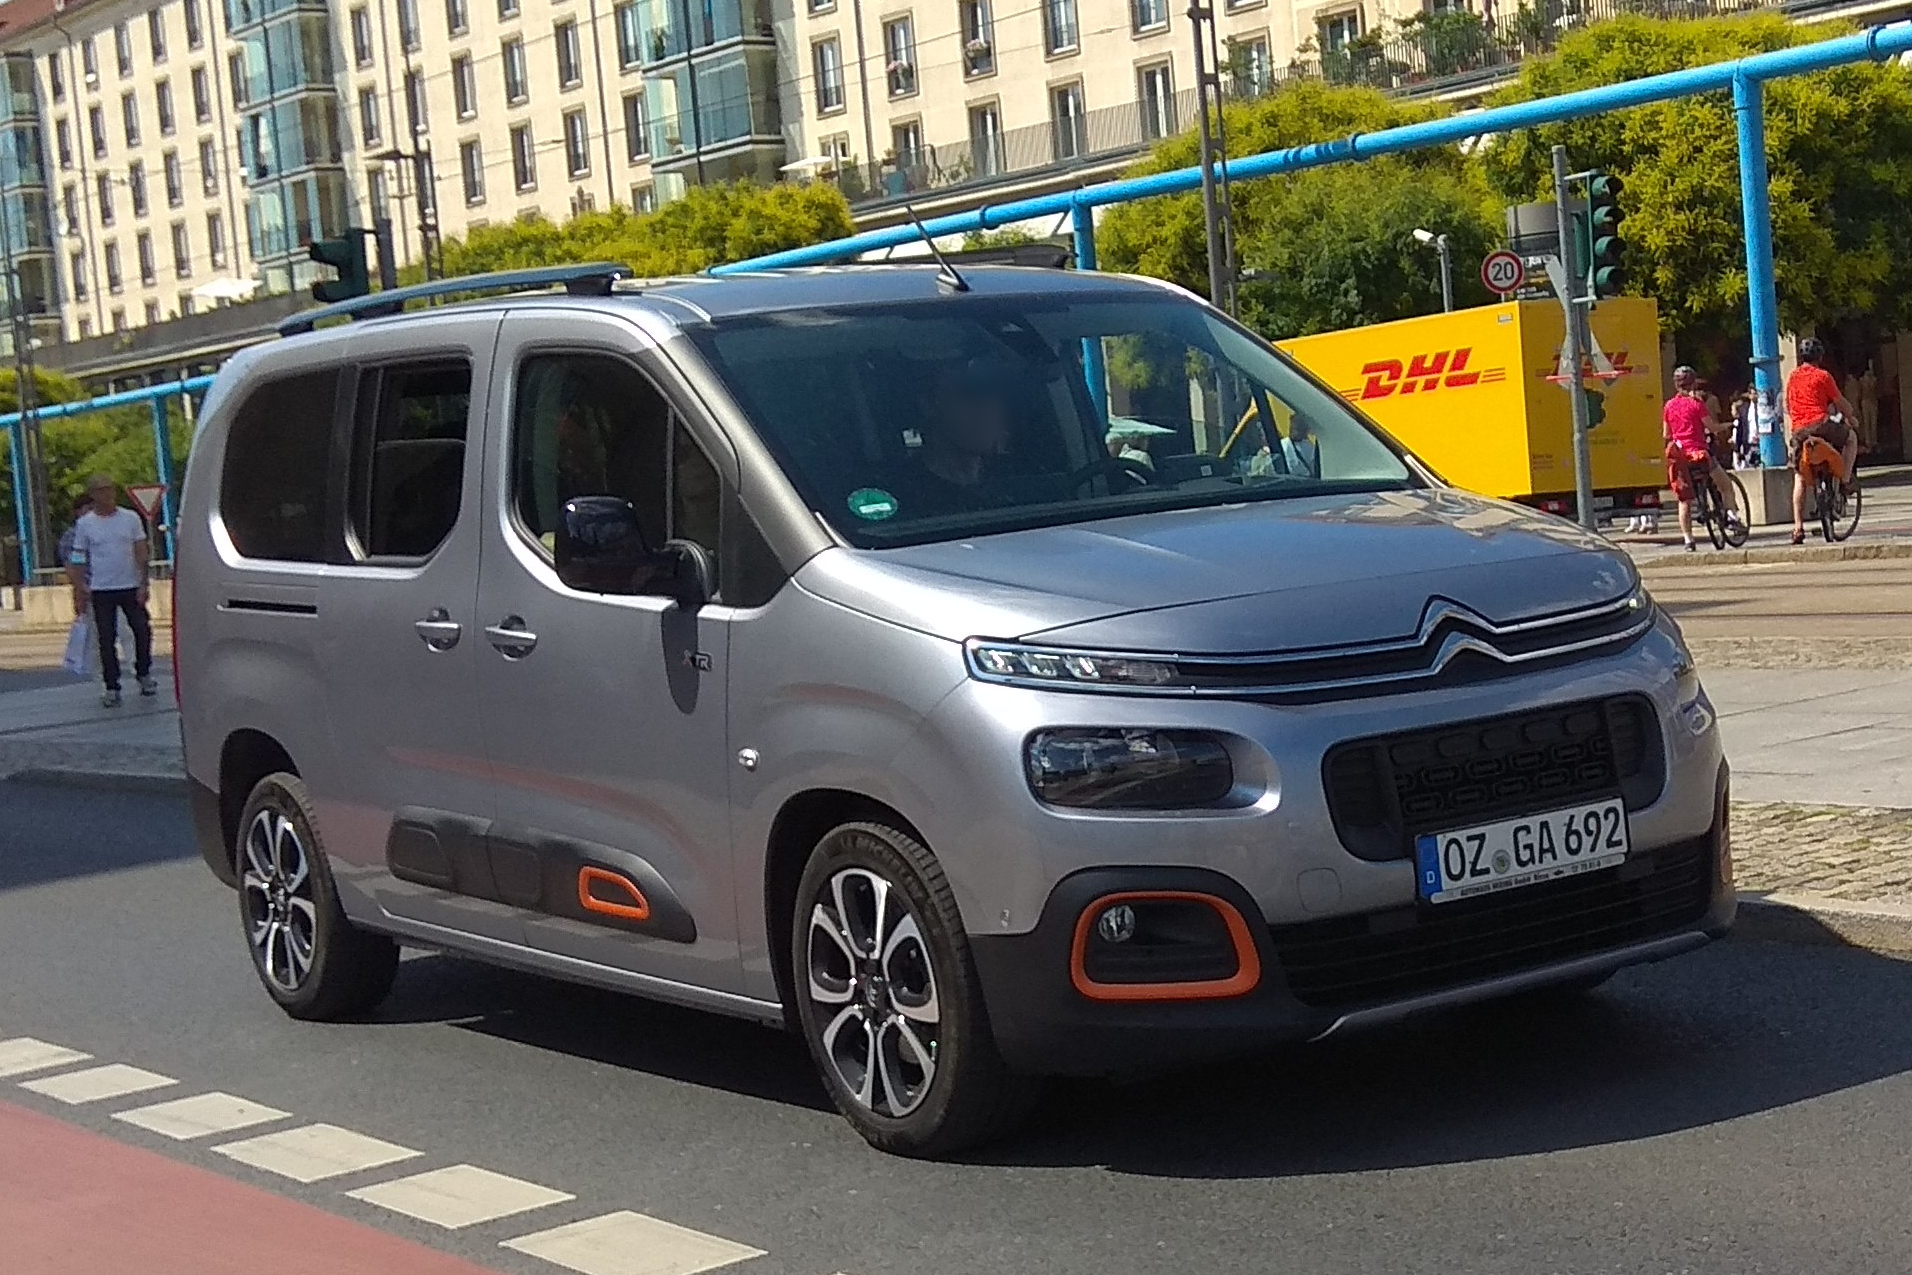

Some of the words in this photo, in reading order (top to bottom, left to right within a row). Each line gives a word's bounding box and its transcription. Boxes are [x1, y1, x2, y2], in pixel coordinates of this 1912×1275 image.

[1491, 261, 1515, 282] 20
[1360, 346, 1482, 401] DHL
[1443, 832, 1491, 882] OZ
[1512, 820, 1558, 868] GA
[1564, 806, 1623, 856] 692
[1427, 871, 1436, 883] D
